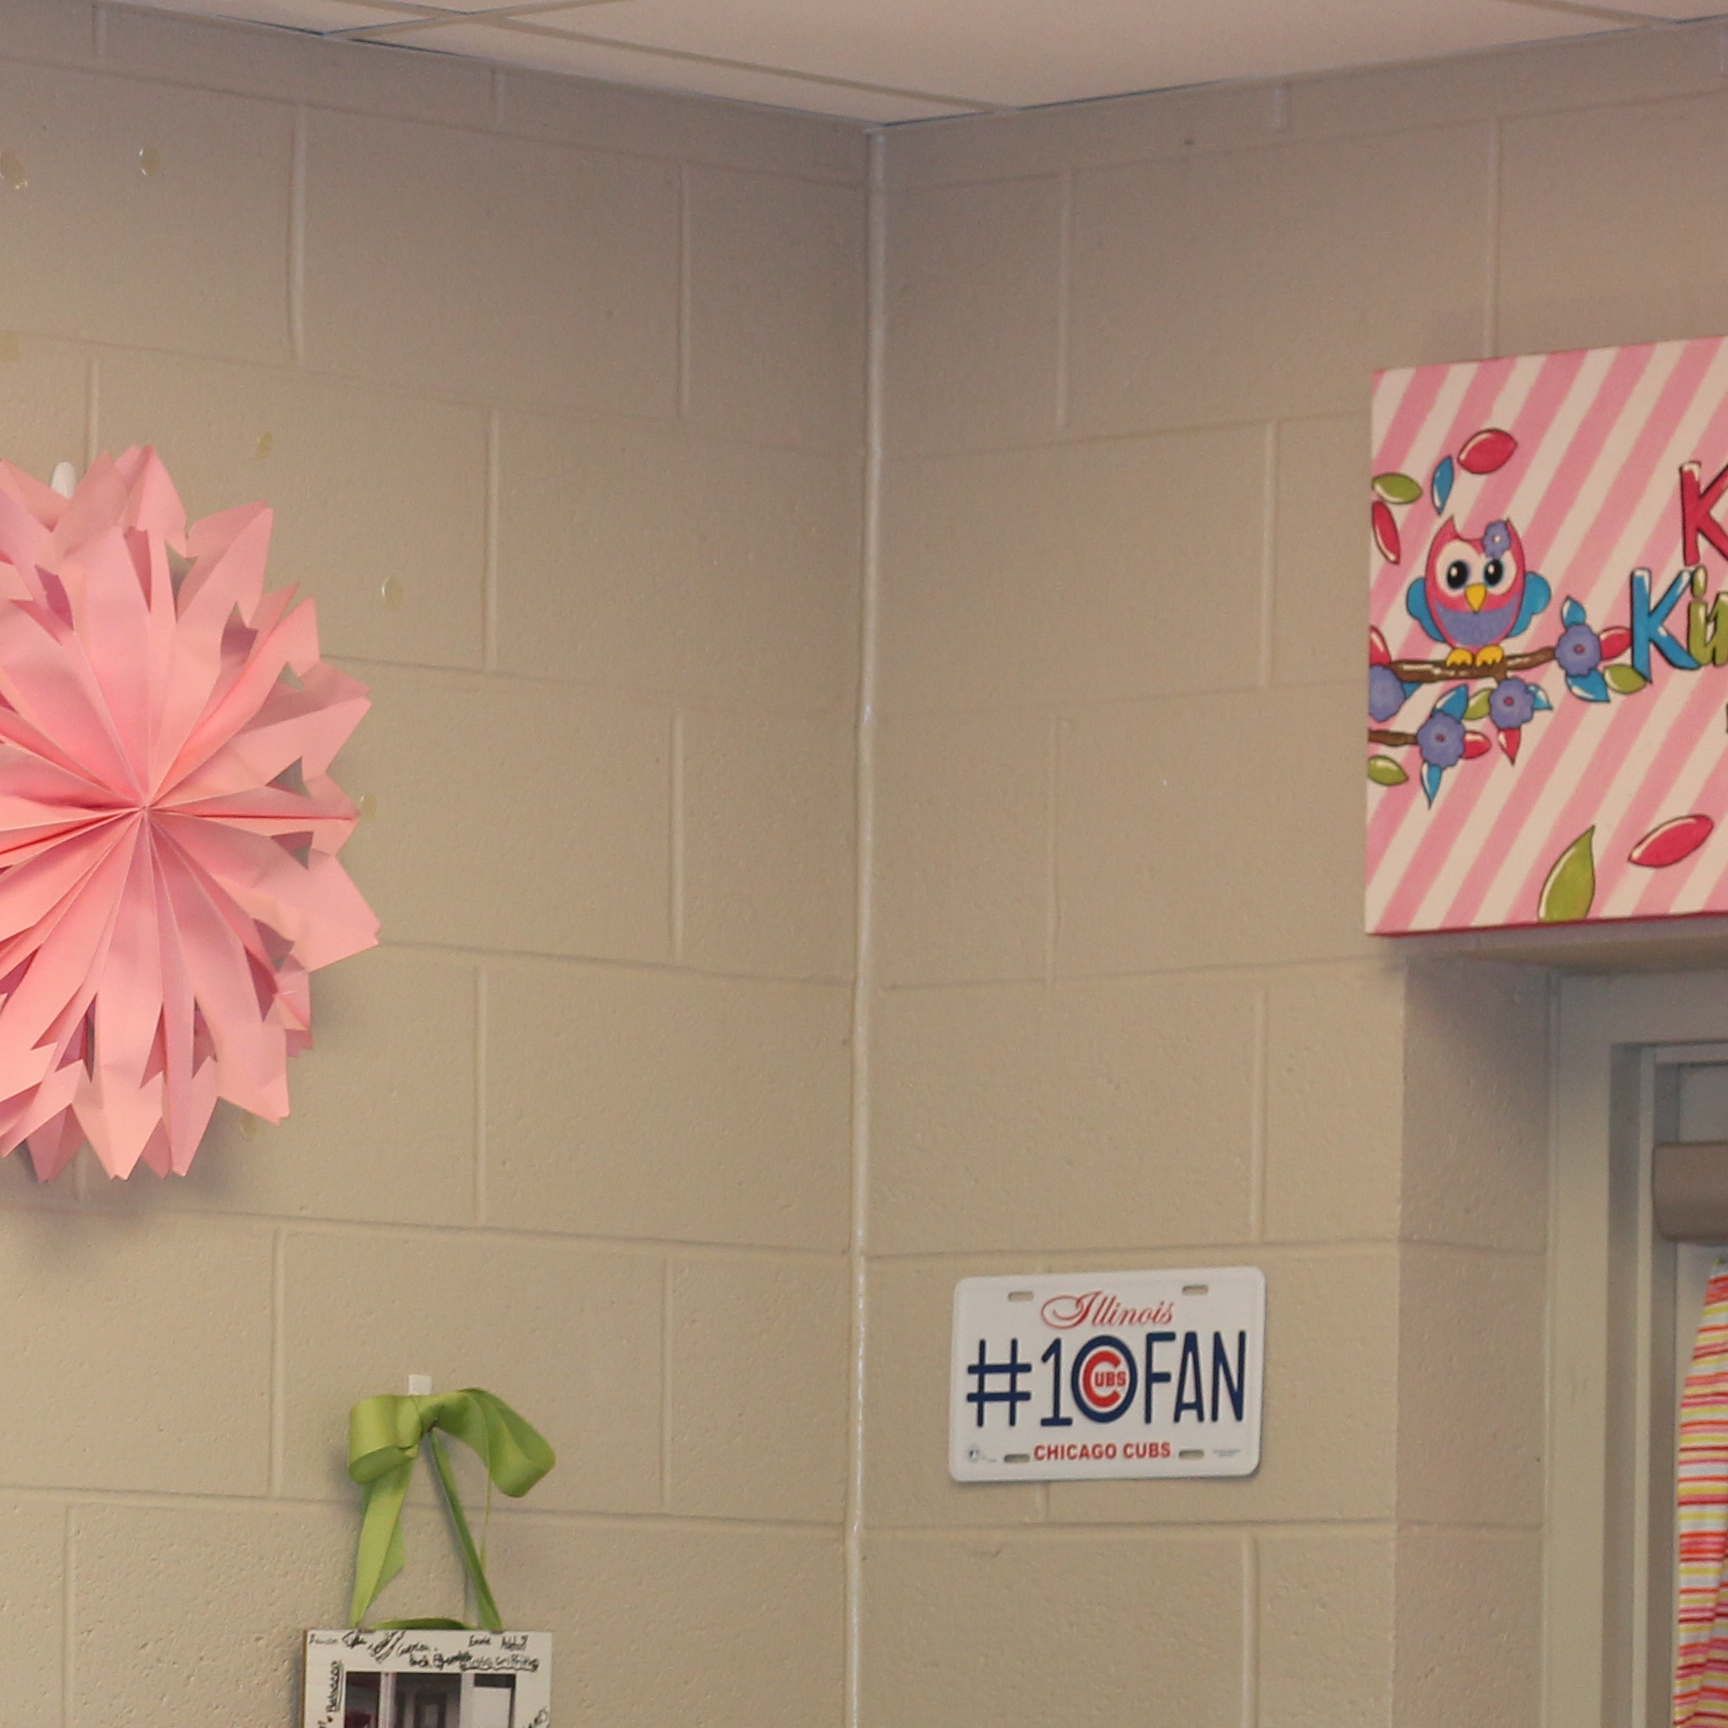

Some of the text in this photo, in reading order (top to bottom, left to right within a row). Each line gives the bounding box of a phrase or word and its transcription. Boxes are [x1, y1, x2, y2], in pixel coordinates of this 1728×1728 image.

[1041, 1290, 1175, 1330] Illinois
[967, 1337, 1072, 1427] #1
[1144, 1330, 1246, 1425] FAN
[1033, 1441, 1172, 1462] CHICAGO CUBS
